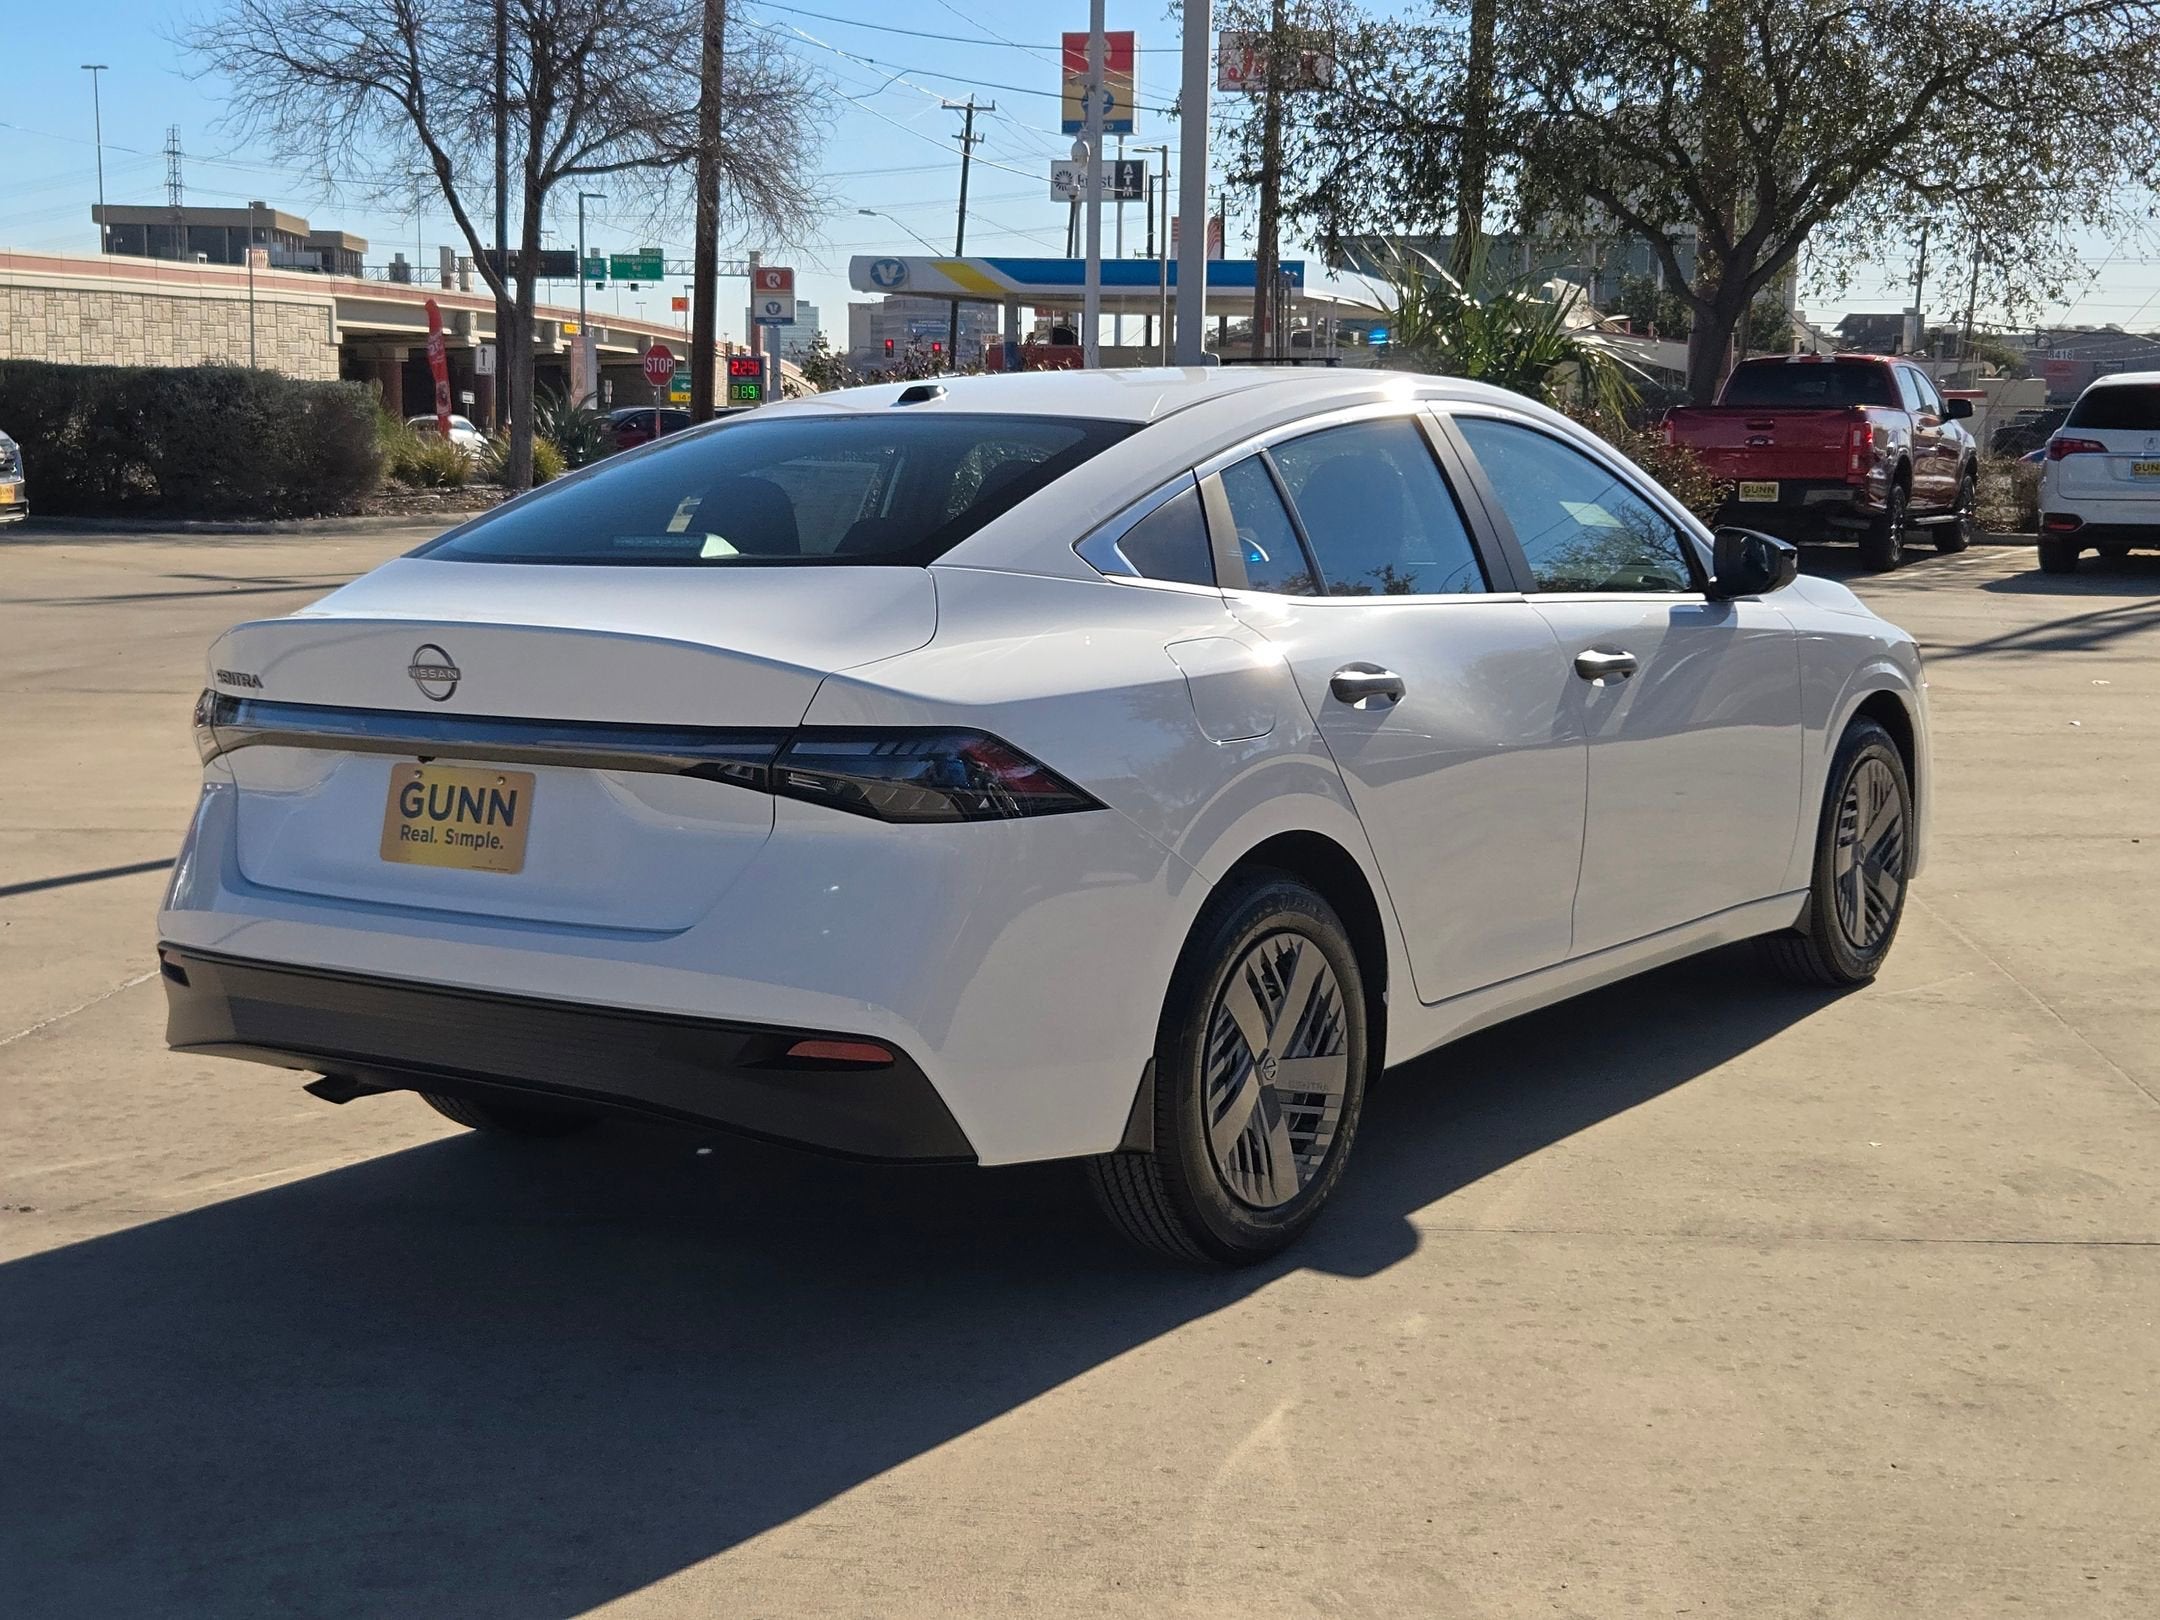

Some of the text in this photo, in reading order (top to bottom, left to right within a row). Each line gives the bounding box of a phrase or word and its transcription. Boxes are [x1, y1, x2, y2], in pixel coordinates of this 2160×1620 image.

[1123, 163, 1134, 197] ATM
[646, 357, 674, 373] STOP
[2133, 463, 2160, 472] GUN
[1743, 485, 1776, 495] GUNN
[408, 667, 458, 679] NISSAN
[399, 781, 518, 827] GUNN
[400, 824, 438, 844] Real.
